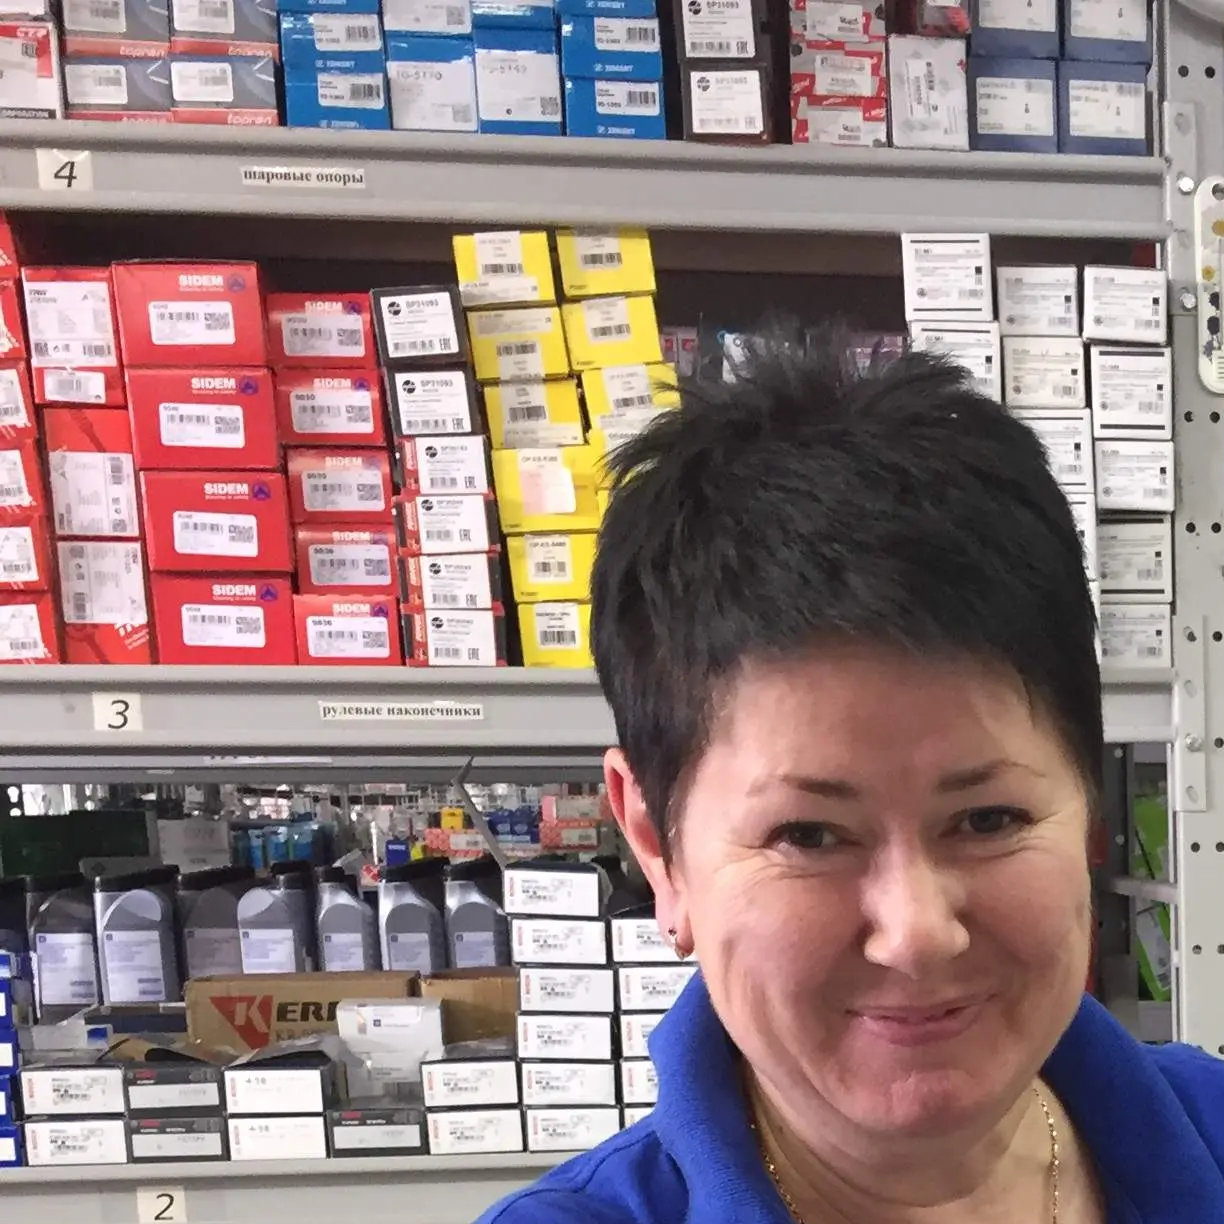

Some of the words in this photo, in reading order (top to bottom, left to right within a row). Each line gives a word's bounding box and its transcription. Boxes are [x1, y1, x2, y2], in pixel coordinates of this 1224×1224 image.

[227, 112, 272, 125] topran
[53, 160, 77, 188] 4
[316, 171, 364, 185] опоры
[178, 274, 224, 287] SIDEM
[191, 377, 236, 390] SIDEM
[312, 378, 351, 388] SIDEM
[204, 482, 249, 495] SIDEM
[332, 531, 371, 541] SIDEM
[212, 584, 256, 597] SIDEM
[332, 603, 371, 614] SIDEM
[106, 700, 131, 729] 3
[322, 704, 383, 718] рулевые
[387, 705, 482, 718] наконечники
[153, 1193, 175, 1221] 2
